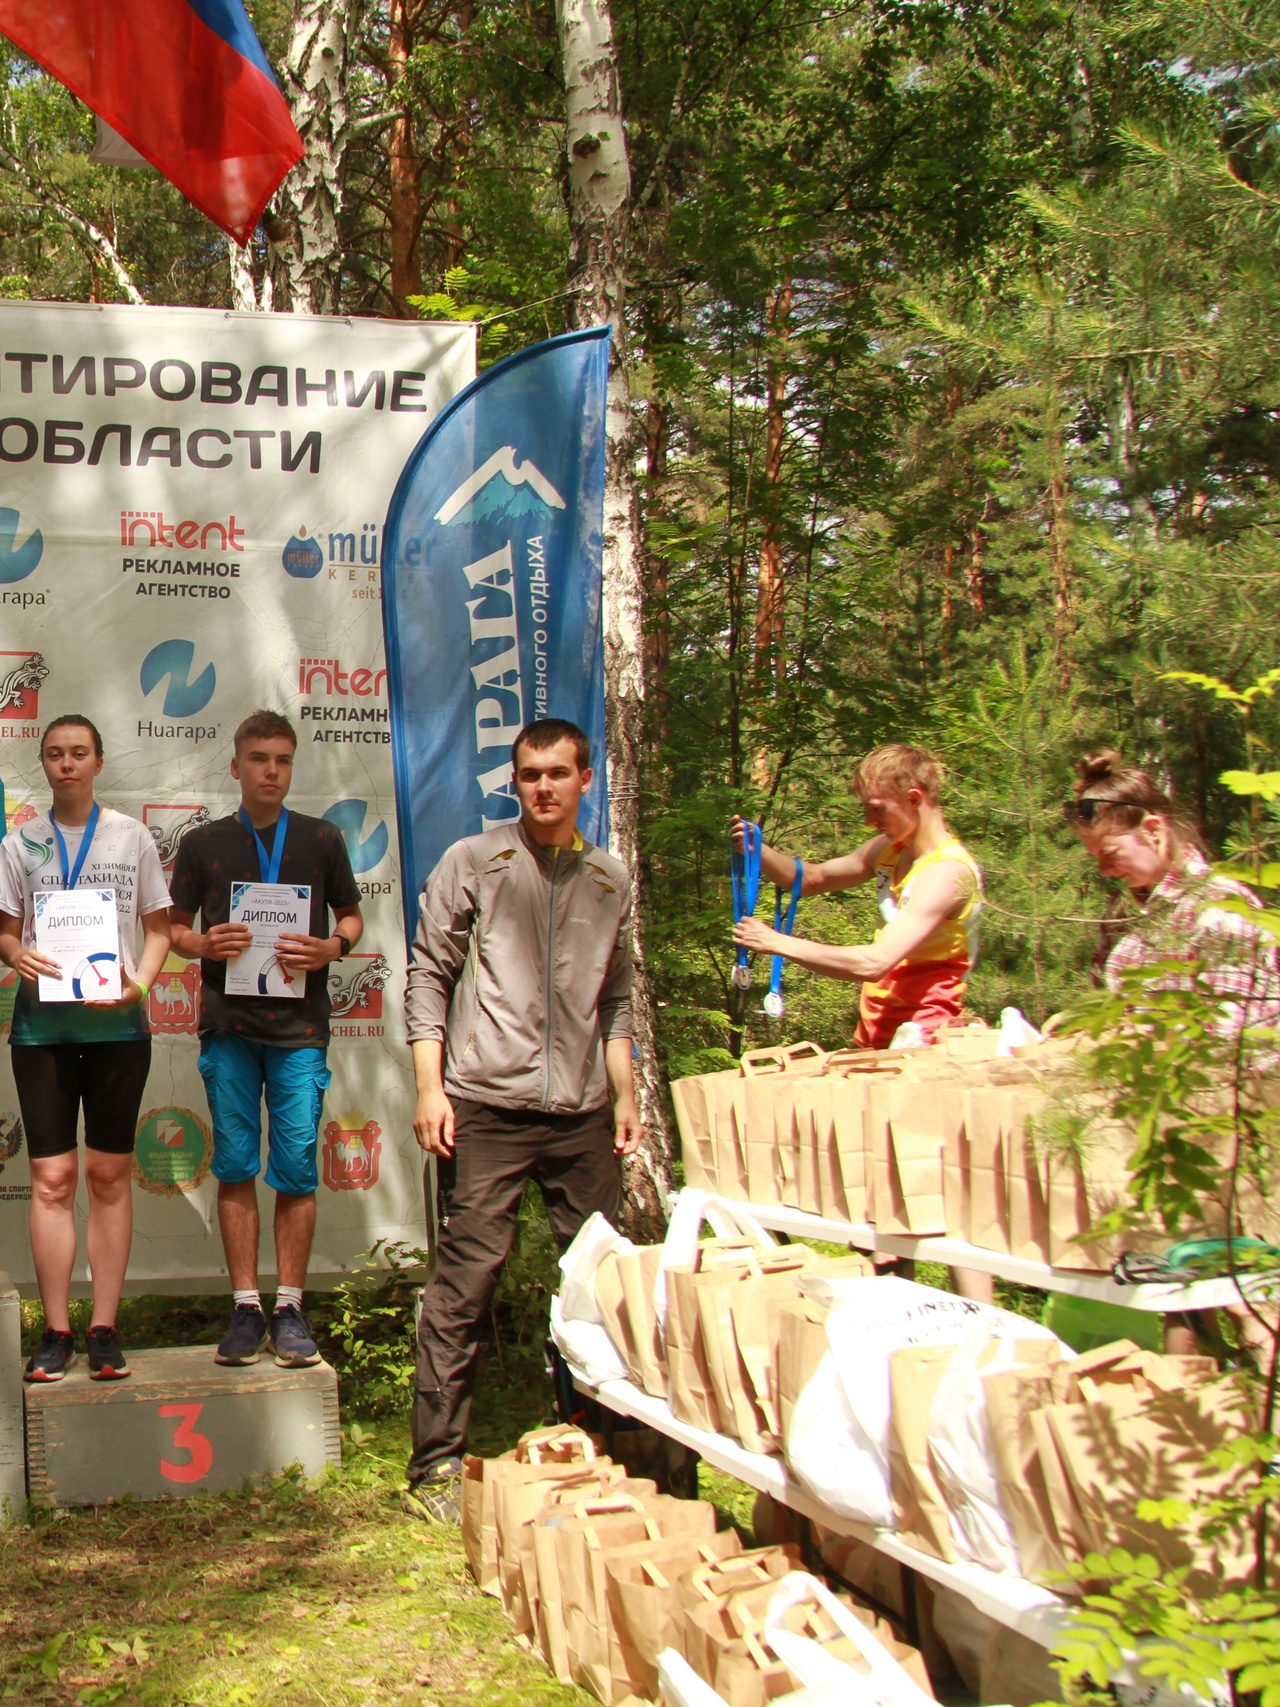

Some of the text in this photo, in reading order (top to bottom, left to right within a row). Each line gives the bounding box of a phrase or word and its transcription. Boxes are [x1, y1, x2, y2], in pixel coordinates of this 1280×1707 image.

[121, 511, 245, 551] intent
[122, 559, 240, 577] РЕКЛАМНОЕ
[526, 535, 550, 623] ОТДЫХА
[136, 583, 230, 599] АГЕНТСТВО
[138, 721, 216, 743] Ниагара
[312, 730, 391, 744] АГЕНТСТВ
[103, 863, 136, 873] ЗИМНЯЯ
[41, 873, 134, 887] СПАТАКИАДА
[48, 915, 104, 929] ДИПЛОМ
[241, 909, 297, 923] ДИПЛОМ
[158, 1403, 213, 1483] 3
